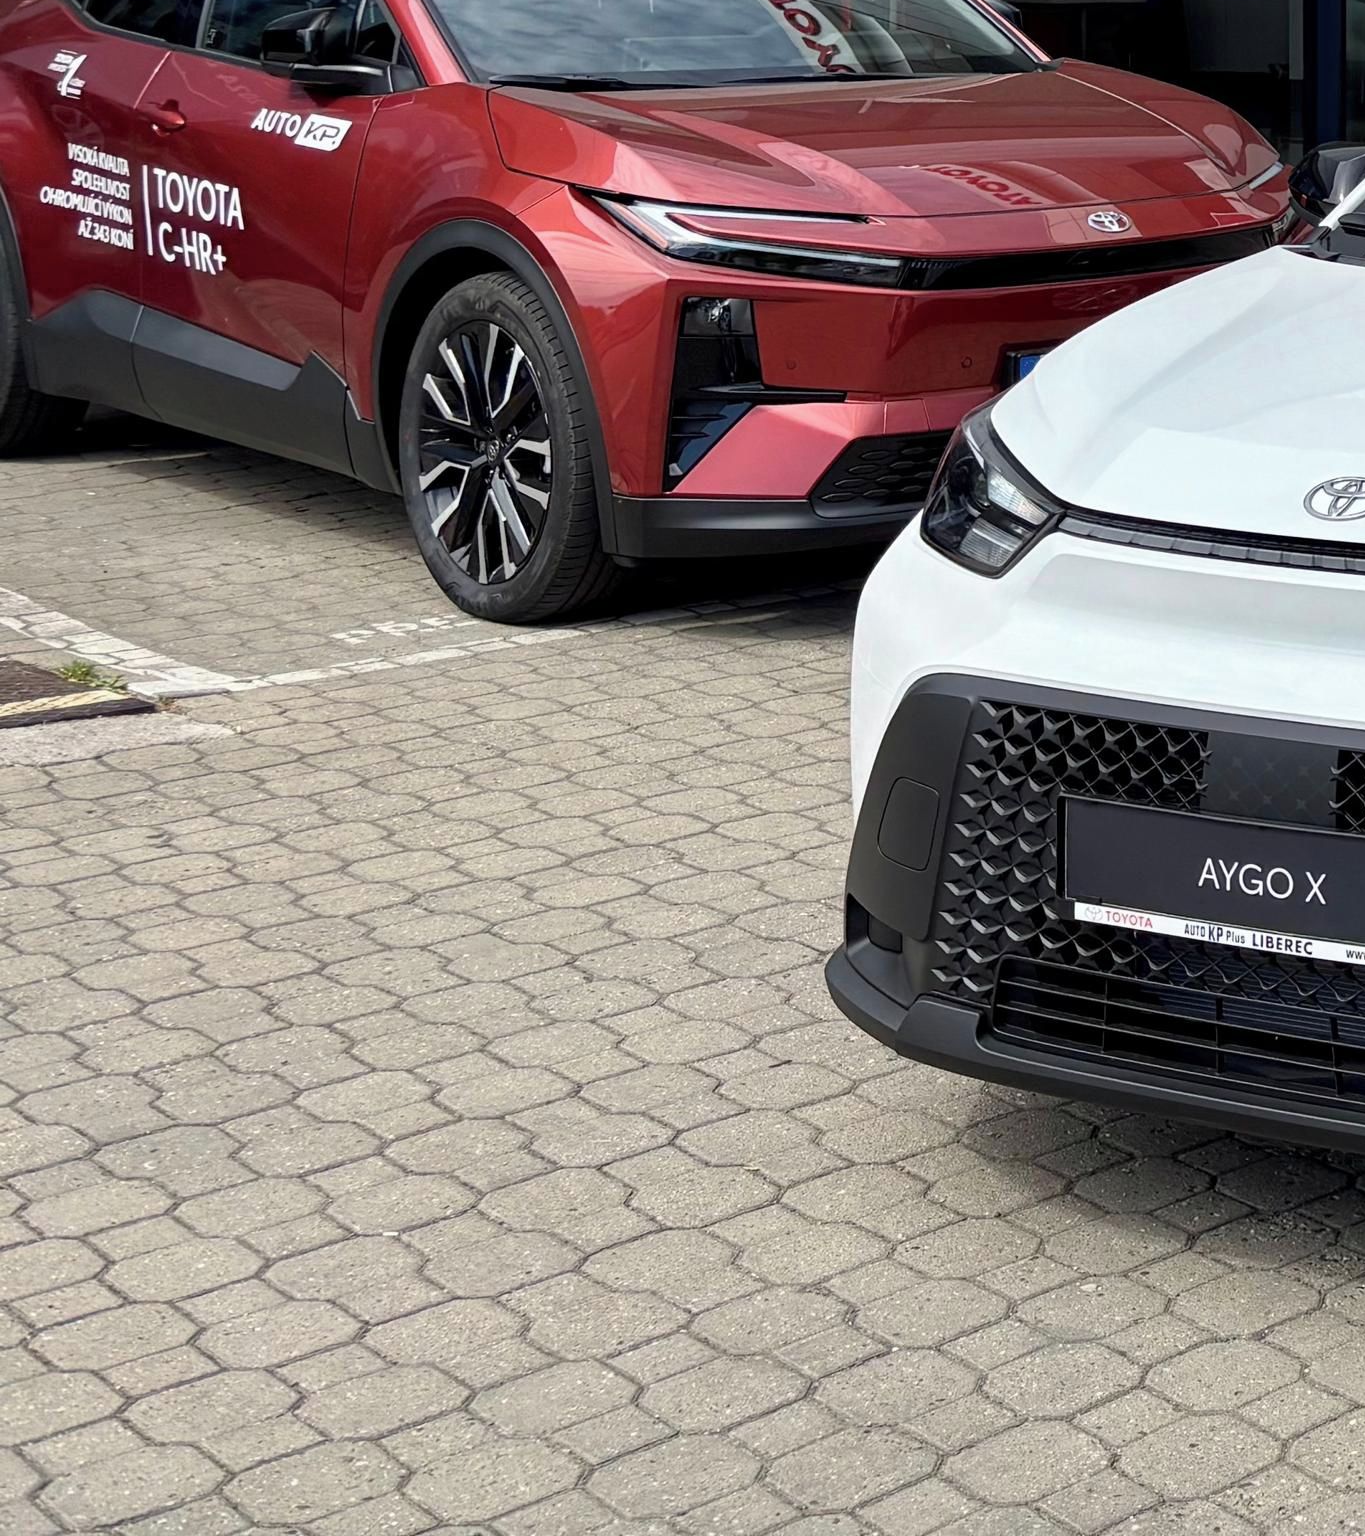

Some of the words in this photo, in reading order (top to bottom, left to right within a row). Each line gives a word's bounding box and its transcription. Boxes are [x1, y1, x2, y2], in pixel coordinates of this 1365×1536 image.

[250, 108, 302, 138] AUTO
[68, 142, 99, 166] VYSOKÁ
[99, 151, 130, 177] KVALITA
[71, 168, 131, 201] SPOLEHLIVOST
[153, 167, 245, 231] TOYOTA
[39, 185, 102, 217] OHROMUJÍCÍ
[102, 198, 133, 226] VÝKON
[78, 216, 92, 239] AŽ
[92, 223, 110, 244] 343
[110, 228, 134, 250] KONÍ
[158, 221, 227, 275] C-HR+
[1198, 857, 1294, 901] AYGO
[1305, 871, 1328, 905] X
[1105, 910, 1153, 930] TOYOTA
[1208, 923, 1224, 942] KP
[1226, 930, 1245, 945] Plus
[1252, 932, 1313, 956] LIBEREC
